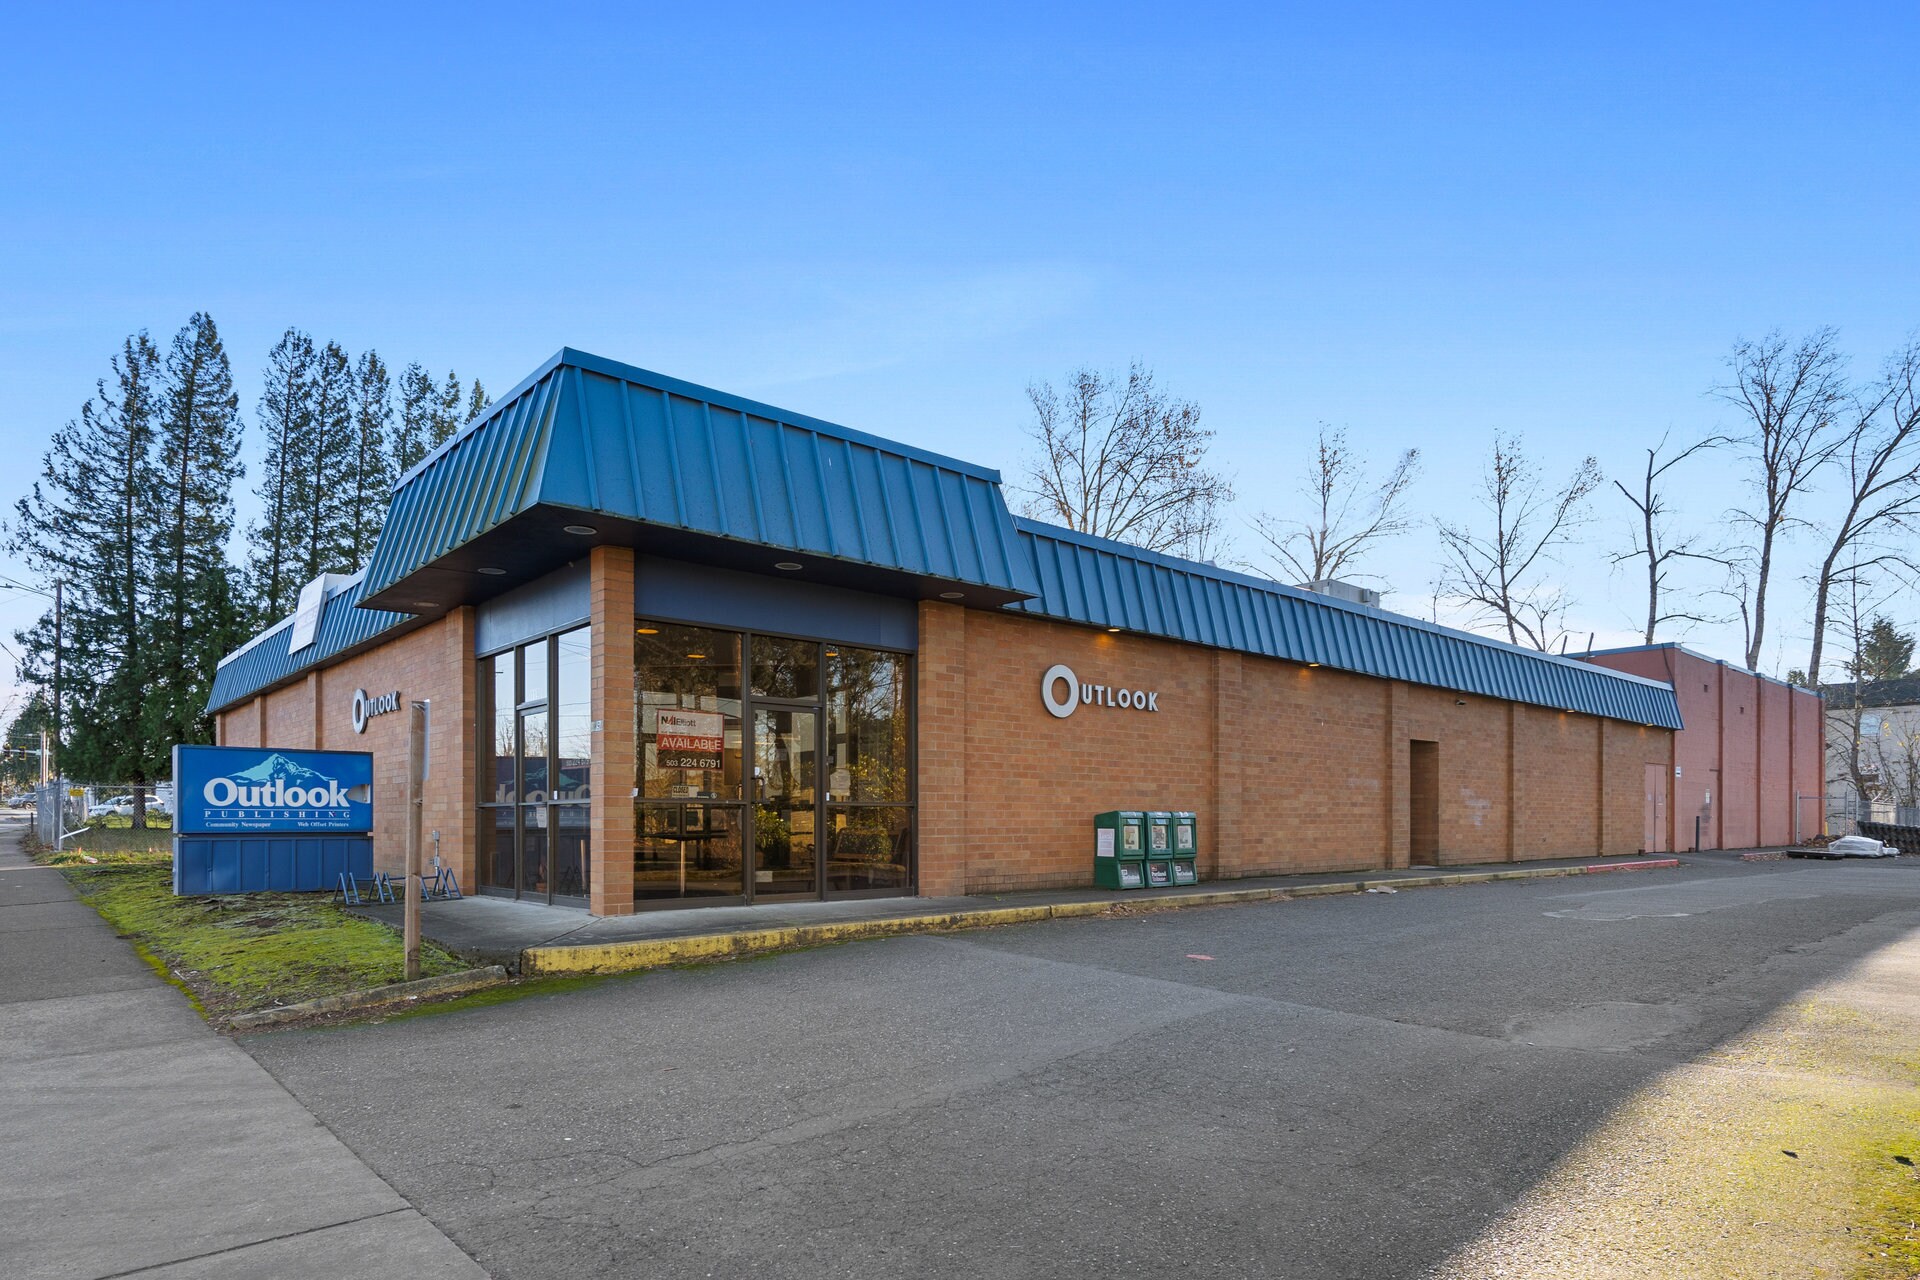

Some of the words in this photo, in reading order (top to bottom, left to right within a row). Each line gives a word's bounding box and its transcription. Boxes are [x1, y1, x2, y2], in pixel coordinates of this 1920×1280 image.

[661, 737, 722, 750] AVAILABLE
[666, 759, 679, 767] 503
[680, 758, 698, 767] 224
[699, 758, 721, 768] 6791
[203, 777, 351, 807] Outlook
[204, 810, 350, 818] PUBLISHING
[205, 821, 239, 829] Community
